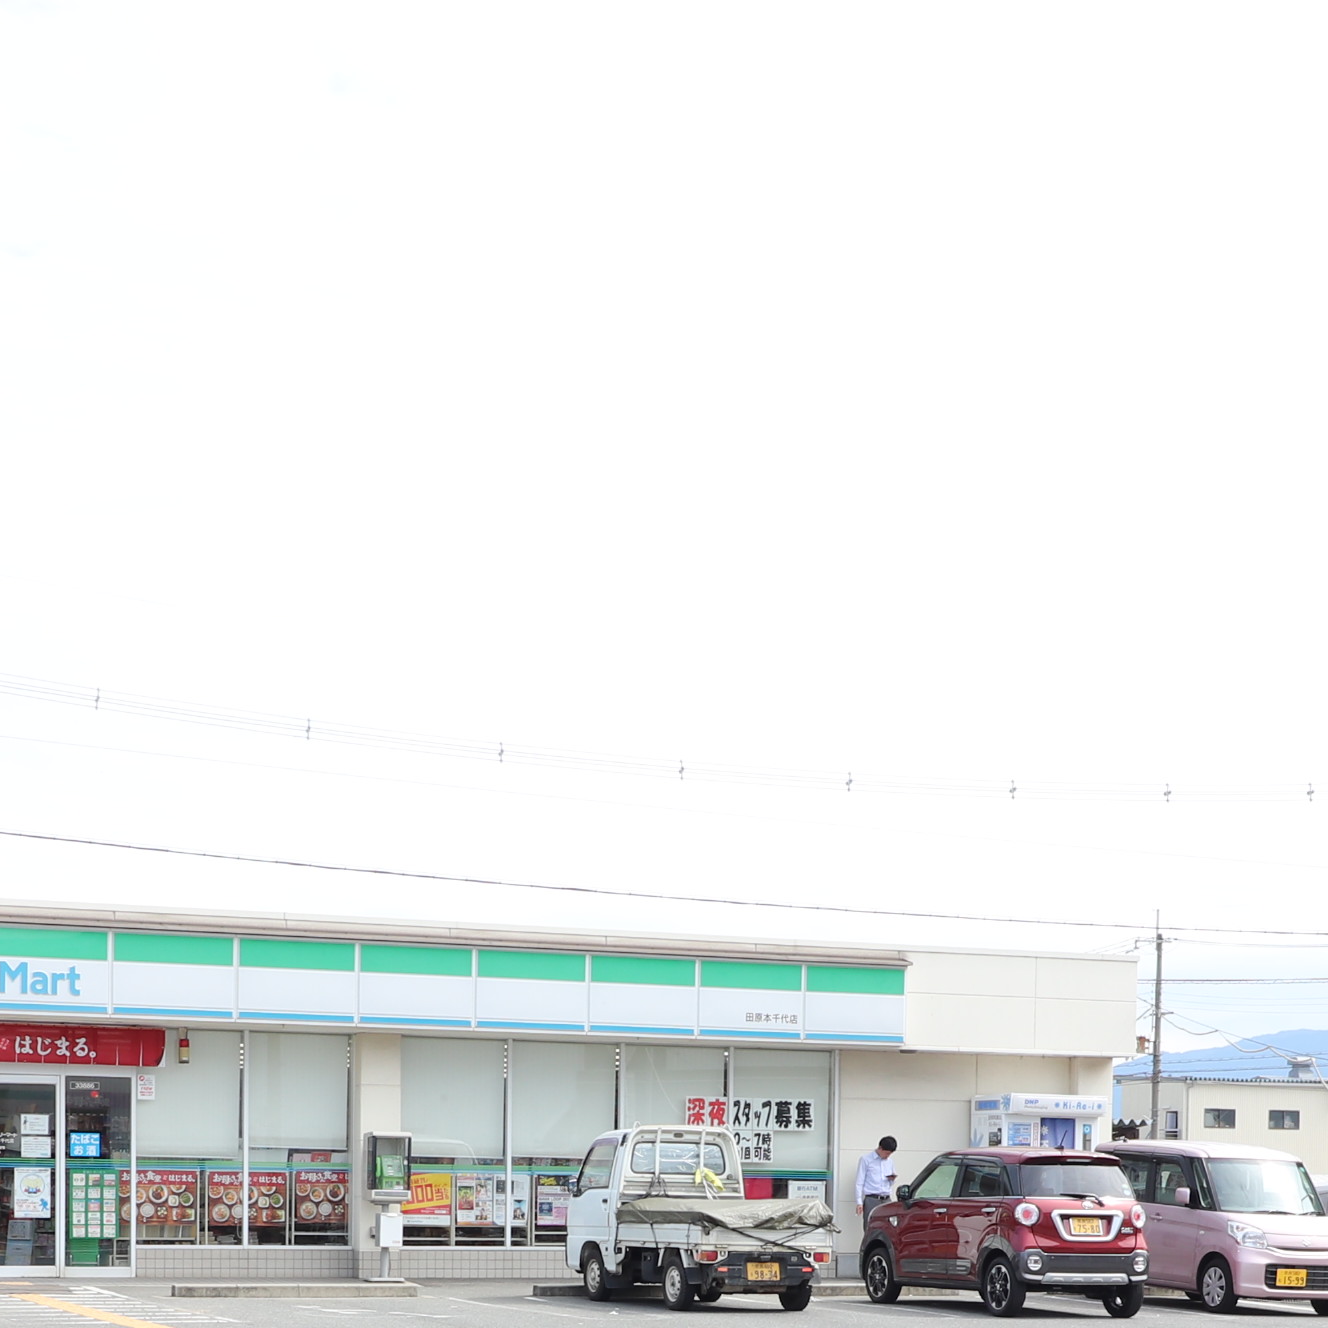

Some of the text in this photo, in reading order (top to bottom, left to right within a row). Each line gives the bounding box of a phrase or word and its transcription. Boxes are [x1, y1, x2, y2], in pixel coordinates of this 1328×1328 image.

[745, 1012, 798, 1025] 田原本千代店
[15, 1035, 97, 1059] はじまる。
[70, 1134, 100, 1144] たばこ
